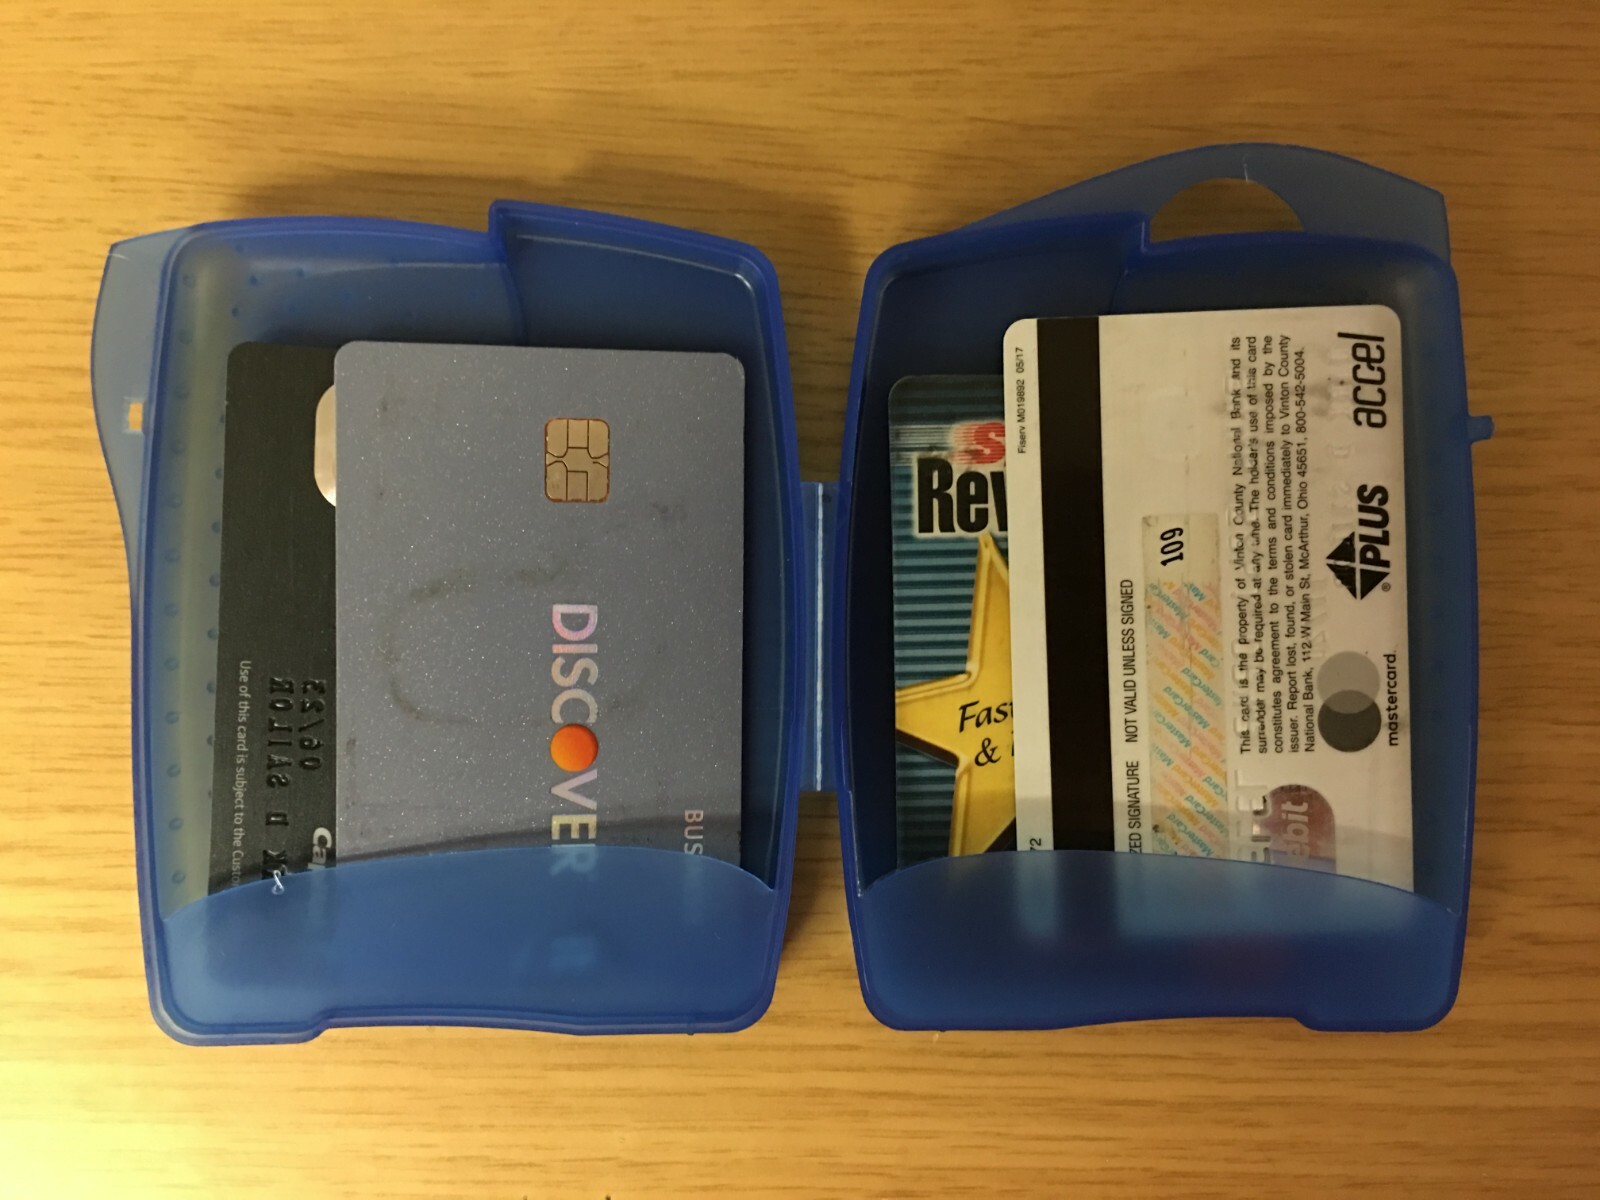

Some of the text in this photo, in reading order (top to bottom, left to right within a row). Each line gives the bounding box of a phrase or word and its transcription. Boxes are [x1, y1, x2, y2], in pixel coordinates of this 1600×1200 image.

[1230, 337, 1240, 351] its
[1245, 336, 1257, 363] card
[1278, 335, 1291, 378] County
[1015, 347, 1024, 374] 05/17
[1231, 358, 1241, 381] and
[1293, 347, 1306, 434] 800-542-5004.
[1337, 331, 1386, 429] accel
[1230, 389, 1242, 420] Bank
[1246, 393, 1257, 406] of
[1278, 382, 1290, 420] Vinton
[1248, 411, 1258, 433] use
[1280, 424, 1290, 435] to
[1017, 426, 1026, 454] Fiserv
[1231, 428, 1244, 477] National
[1294, 436, 1308, 478] 45651,
[1280, 440, 1293, 511] immediately
[1233, 483, 1246, 526] County
[1248, 489, 1260, 513] The
[1296, 480, 1307, 510] Ohio
[1281, 514, 1293, 541] card
[1357, 484, 1390, 567] PLUS
[1159, 527, 1185, 567] 109
[1261, 335, 1284, 754] constitutes agreement to the terms and conditions imposed by the
[1296, 514, 1310, 570] McArthur,
[1282, 545, 1294, 581] stolen
[1235, 578, 1246, 590] of
[1251, 577, 1262, 590] at
[1284, 585, 1295, 597] or
[1236, 597, 1249, 645] property
[1251, 594, 1264, 642] required
[1284, 601, 1297, 639] found,
[1299, 593, 1311, 622] Main
[1300, 625, 1311, 639] W
[1120, 579, 1138, 743] NOT VALID UNLESS SIGNED
[1237, 653, 1249, 672] the
[1285, 643, 1297, 667] lost,
[1301, 641, 1312, 663] 112
[240, 660, 251, 682] Use
[1238, 678, 1249, 689] is
[1302, 667, 1315, 700] Bank,
[239, 686, 250, 698] of
[1286, 671, 1300, 711] Report
[238, 701, 250, 723] this
[958, 699, 1013, 734] Fas
[236, 726, 249, 750] card
[549, 604, 599, 875] DISCOVER
[1239, 730, 1251, 755] This
[1303, 704, 1315, 752] National
[236, 754, 247, 764] is
[973, 737, 1002, 767] &
[232, 767, 246, 809] subject
[1126, 761, 1141, 829] SIGNATURE
[234, 813, 245, 825] to
[233, 827, 245, 847] the
